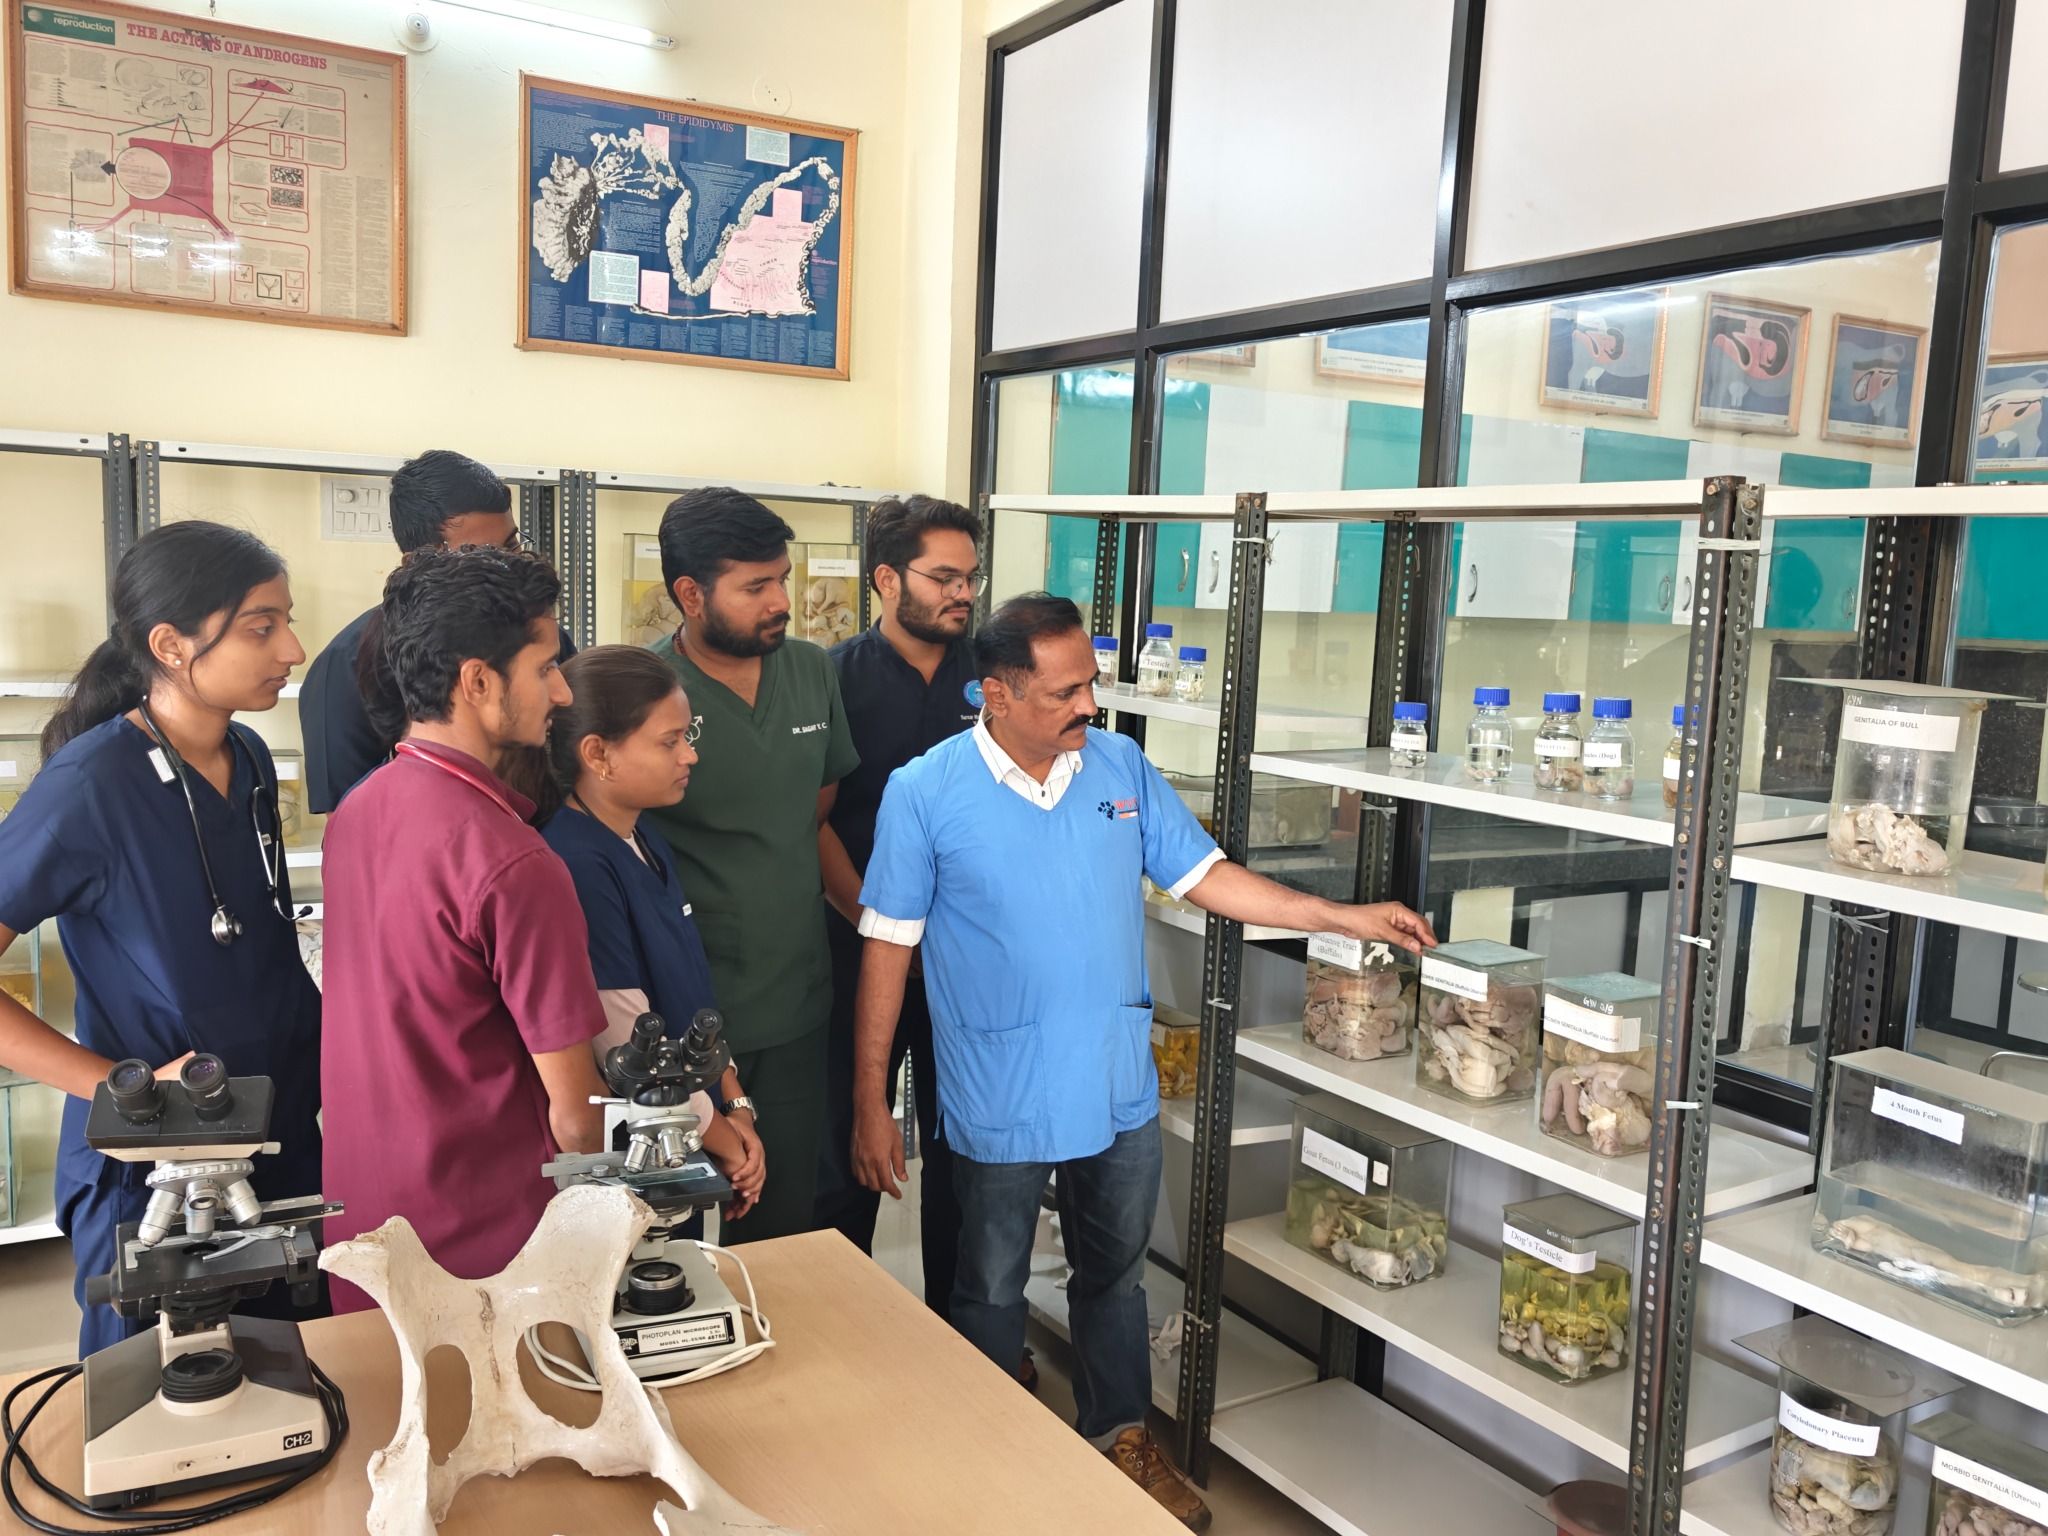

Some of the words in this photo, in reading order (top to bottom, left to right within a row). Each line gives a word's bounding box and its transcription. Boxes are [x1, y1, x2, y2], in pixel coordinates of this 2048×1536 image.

[54, 17, 113, 32] reproduction
[126, 23, 158, 40] THE
[160, 30, 222, 51] ACTIONS
[225, 41, 241, 54] OF
[242, 45, 328, 70] ANDROGENS
[656, 110, 675, 122] THE
[678, 115, 734, 133] EPIDIDYMIS
[1854, 715, 1886, 726] GENITALIA
[1896, 1103, 1920, 1116] Month
[1922, 1111, 1943, 1123] Fetus
[1511, 1230, 1532, 1247] Dog's
[1534, 1240, 1563, 1263] Testicle
[642, 1330, 681, 1340] PHOTOPLAN
[1787, 1408, 1829, 1435] Cotyledonary
[1831, 1430, 1864, 1443] Placenta
[1941, 1460, 1971, 1478] MORBID
[1972, 1474, 2010, 1495] GENITALIA
